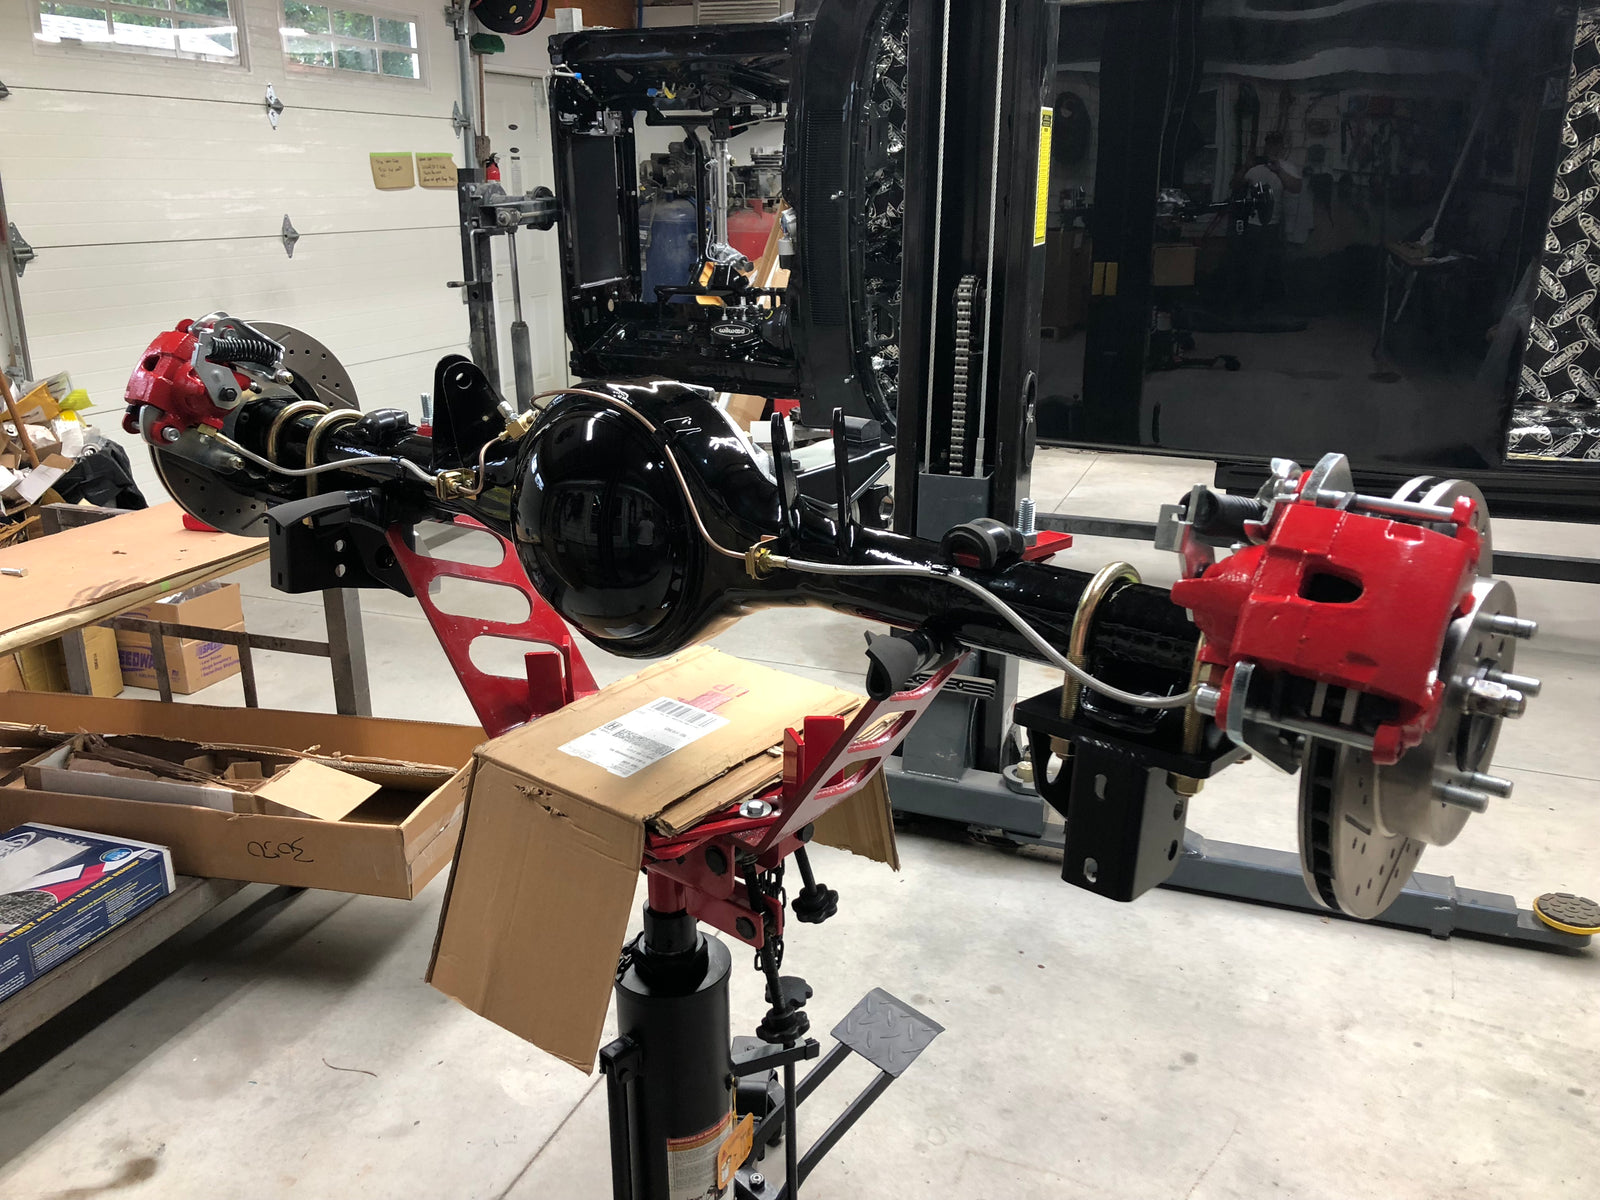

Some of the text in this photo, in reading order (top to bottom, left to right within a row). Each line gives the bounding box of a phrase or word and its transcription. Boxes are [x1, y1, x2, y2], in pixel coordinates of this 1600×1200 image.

[718, 326, 745, 334] wilwood
[8, 921, 36, 938] FIRST
[36, 911, 53, 923] AND
[52, 898, 77, 913] LEAVE
[75, 889, 92, 899] THE
[90, 876, 114, 890] NOISE
